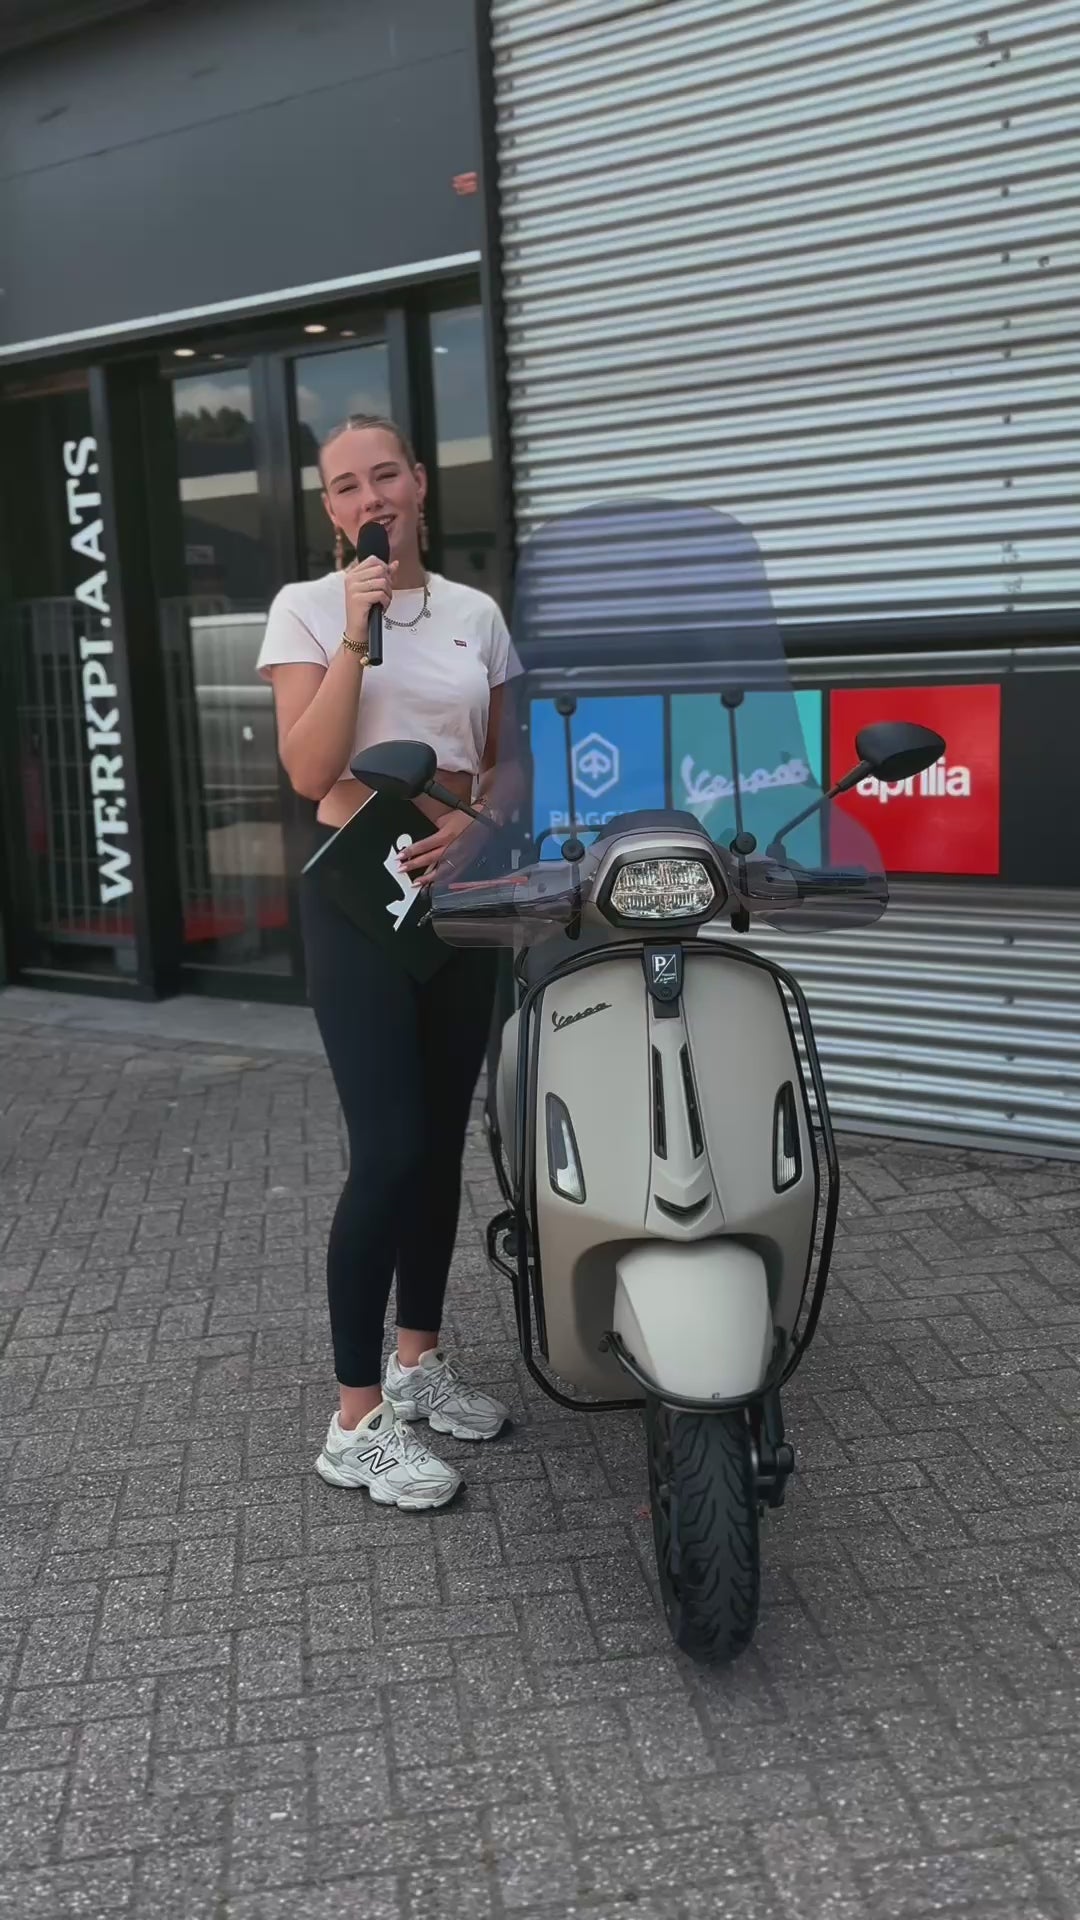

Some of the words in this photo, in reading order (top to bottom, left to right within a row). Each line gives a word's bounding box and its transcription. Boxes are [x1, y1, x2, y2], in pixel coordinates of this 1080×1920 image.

[63, 435, 134, 904] WERKPLAATS
[681, 754, 810, 805] Vespa
[856, 756, 971, 804] aprilia
[551, 1002, 613, 1033] Vespa
[357, 1445, 399, 1476] N
